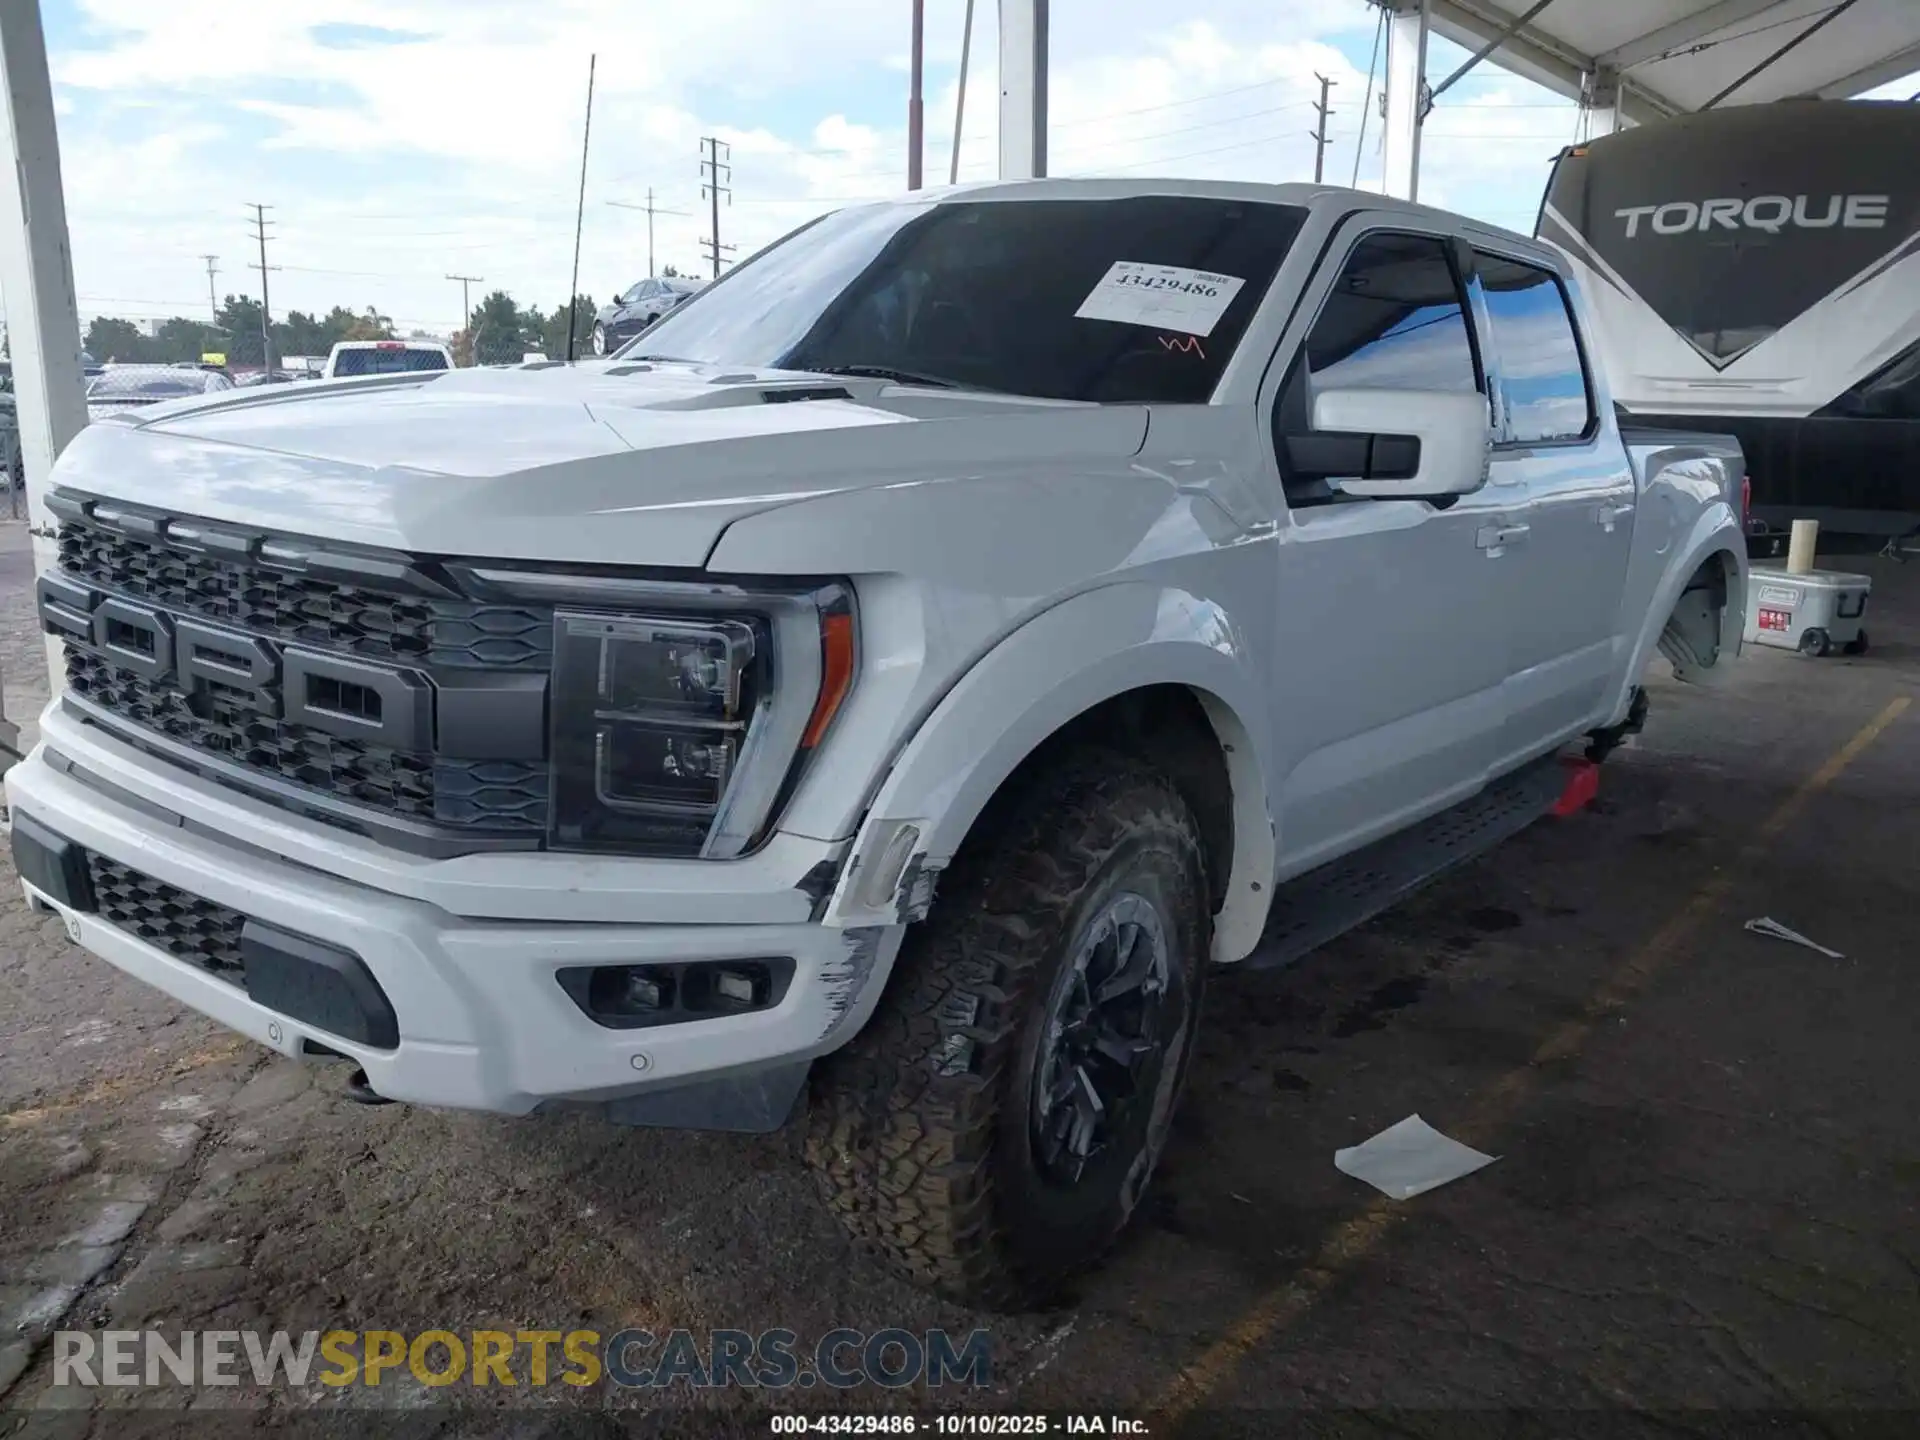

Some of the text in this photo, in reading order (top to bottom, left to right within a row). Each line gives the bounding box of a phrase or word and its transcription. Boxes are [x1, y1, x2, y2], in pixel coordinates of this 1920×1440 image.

[1614, 194, 1890, 239] TORQUE
[1115, 274, 1218, 298] 43429486
[37, 569, 439, 754] FORD
